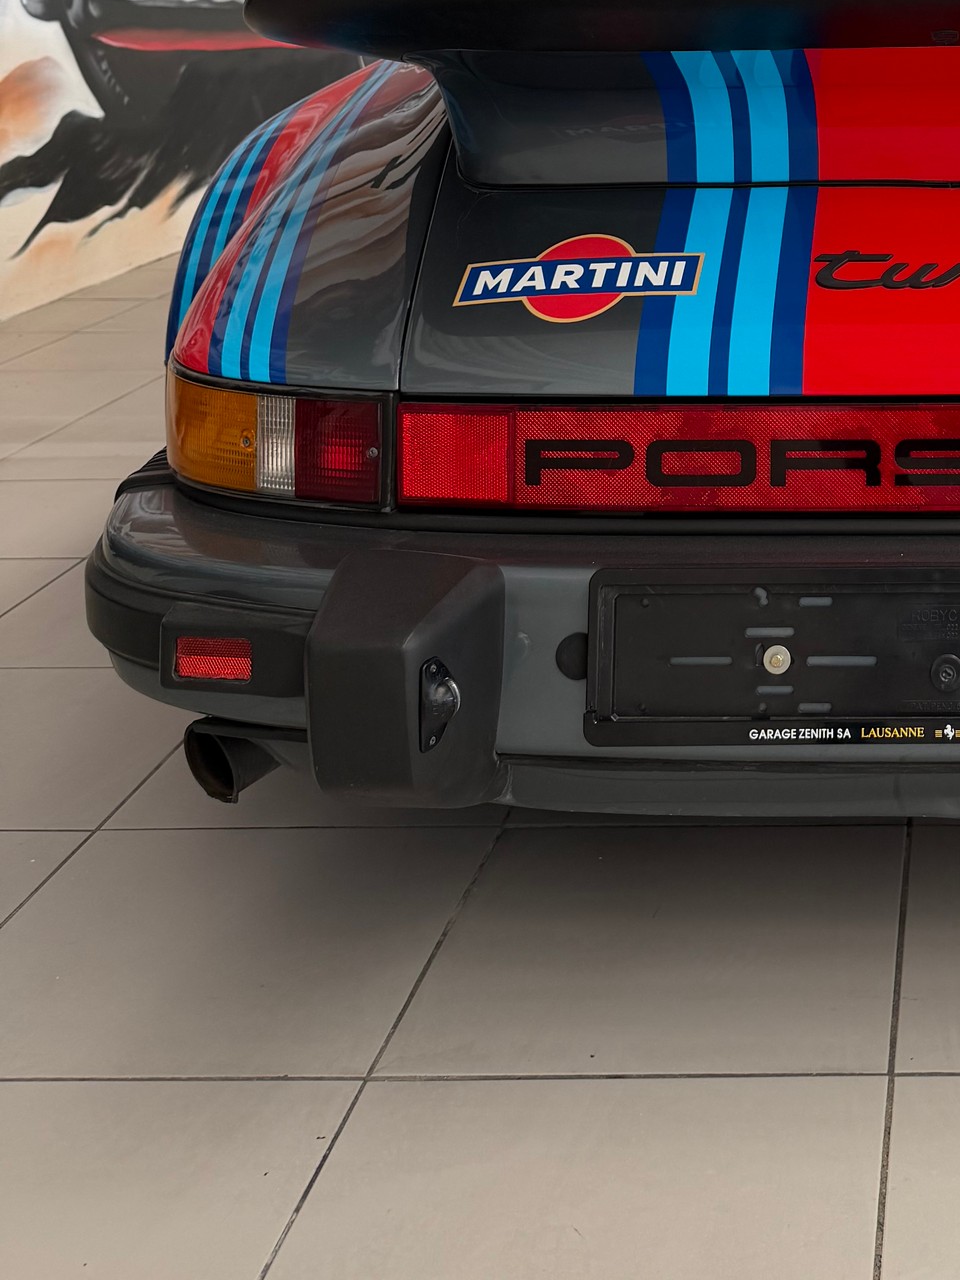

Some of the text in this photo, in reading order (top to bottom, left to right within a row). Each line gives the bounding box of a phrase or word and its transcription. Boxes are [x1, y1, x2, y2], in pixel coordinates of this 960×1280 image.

[472, 261, 686, 296] MARTINI
[748, 728, 797, 740] GARAGE
[798, 728, 834, 739] ZENITH
[836, 728, 851, 739] SA
[861, 727, 925, 738] LAUSANNE
